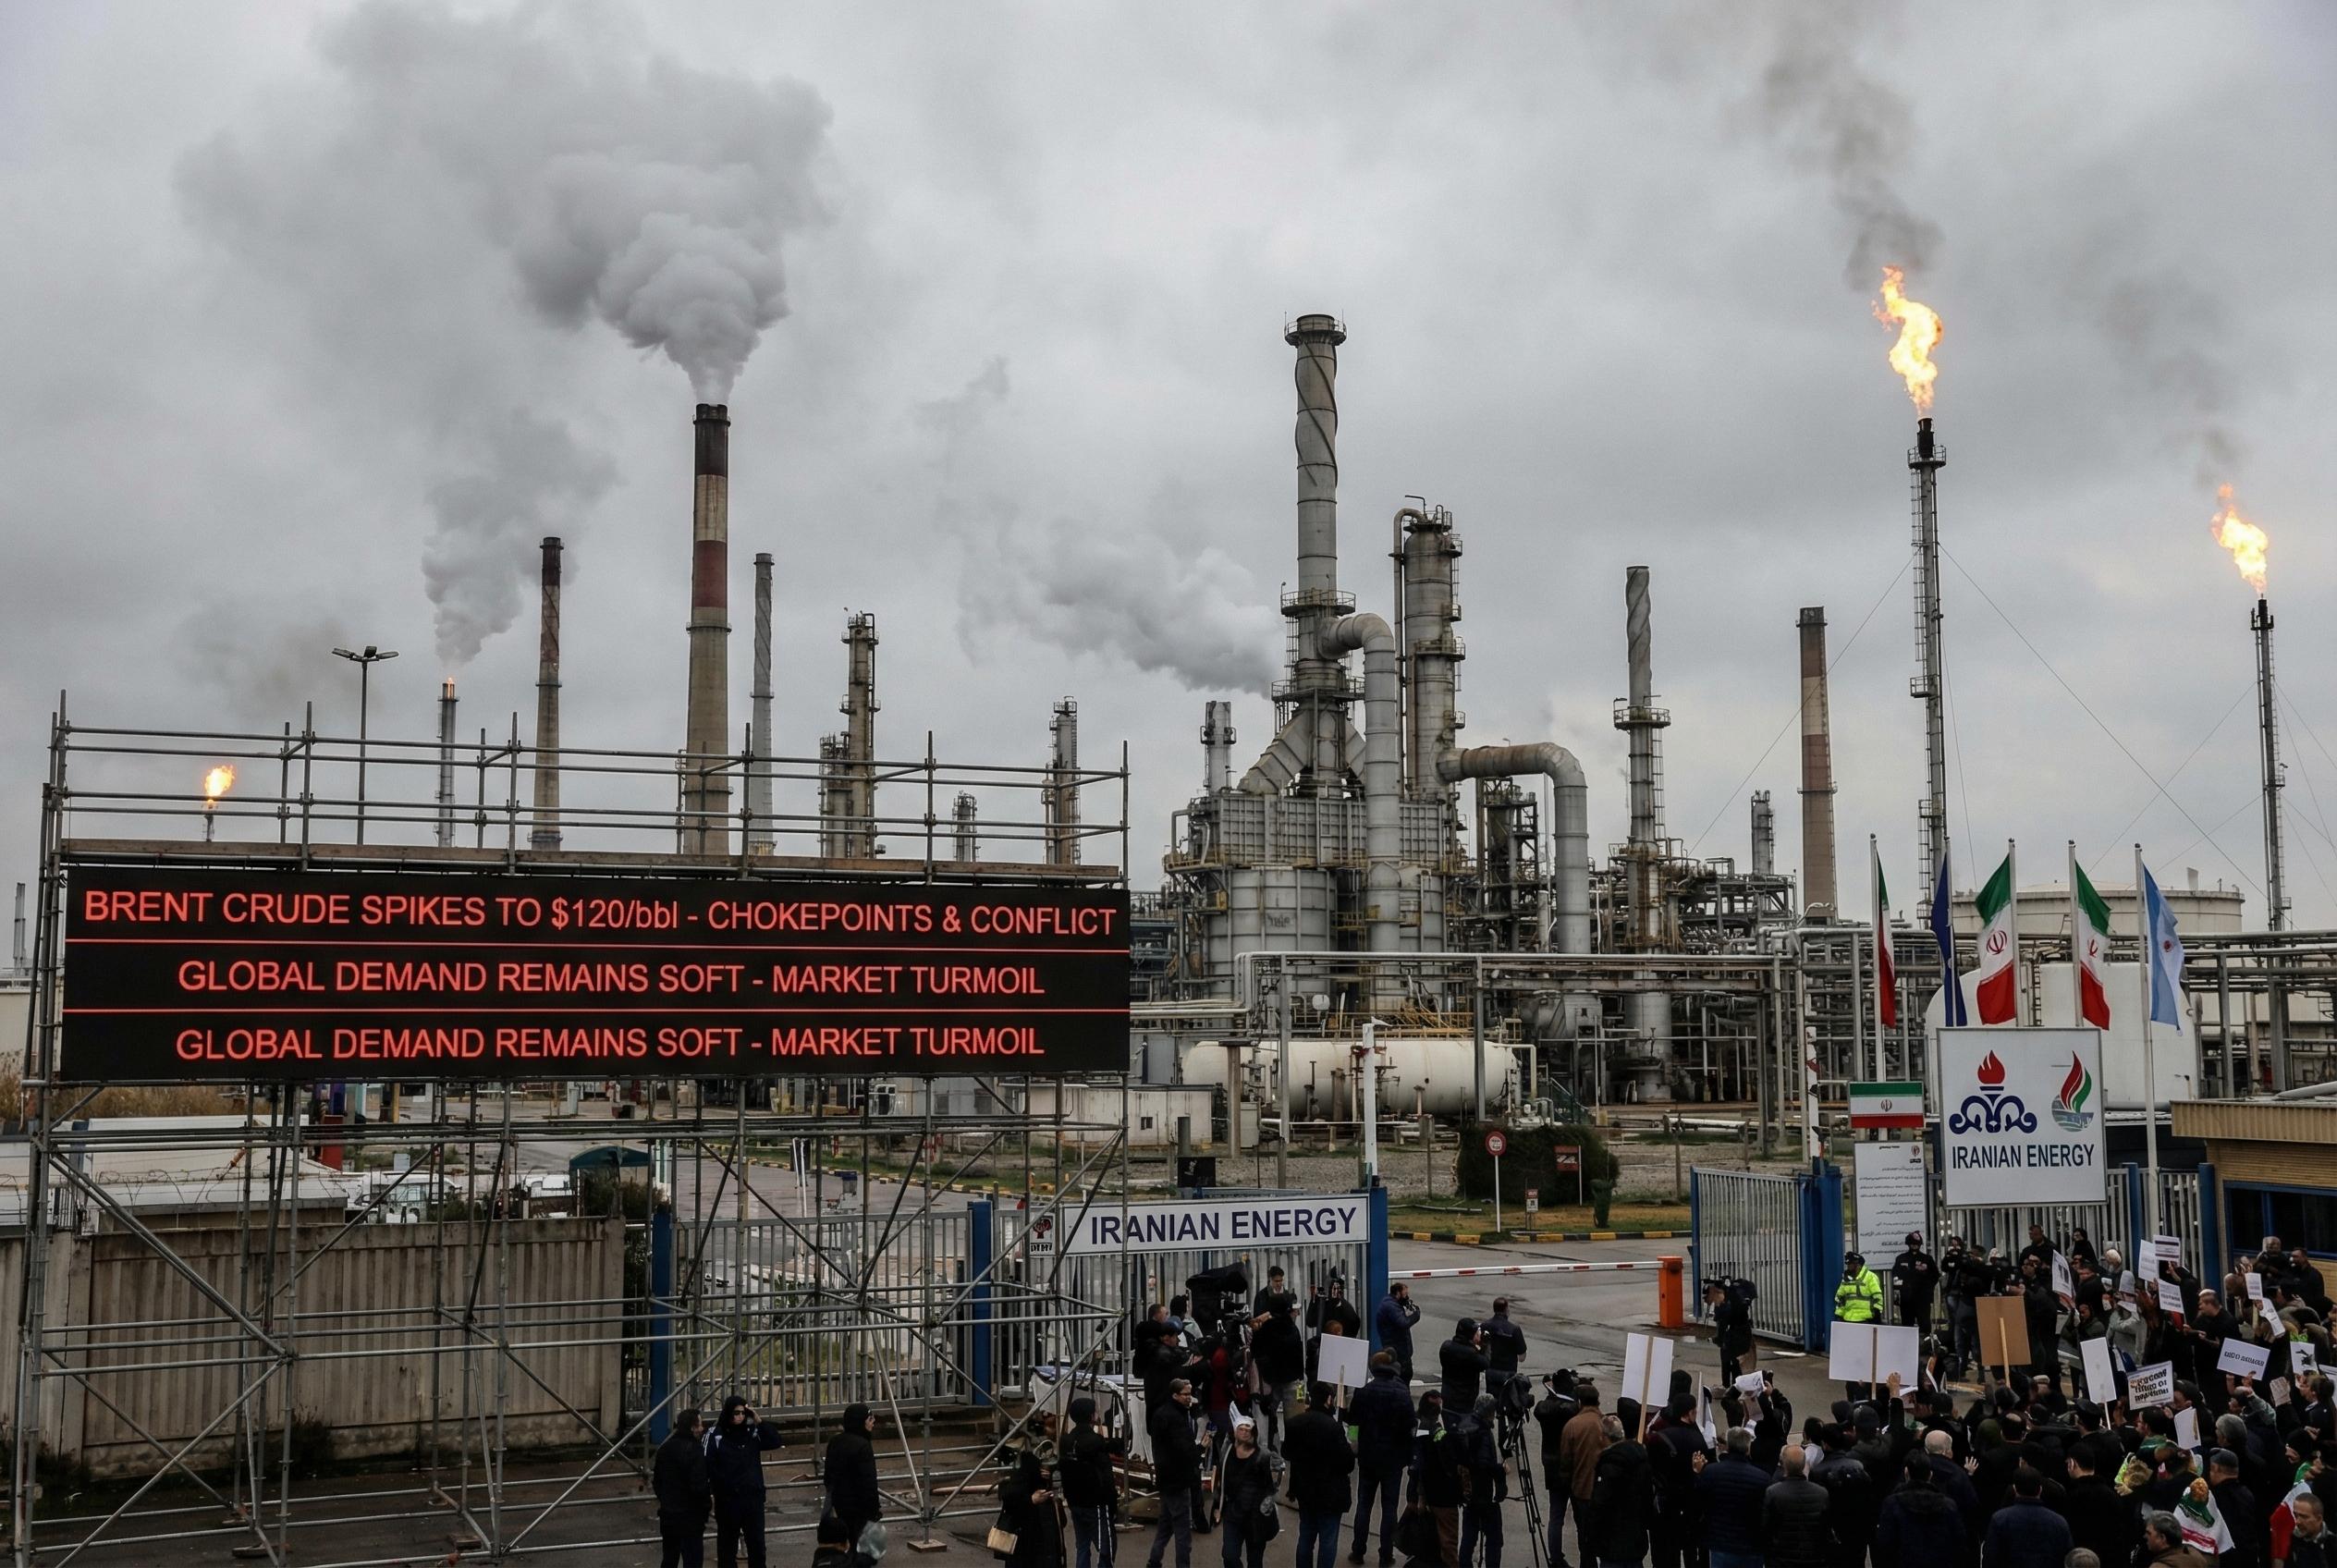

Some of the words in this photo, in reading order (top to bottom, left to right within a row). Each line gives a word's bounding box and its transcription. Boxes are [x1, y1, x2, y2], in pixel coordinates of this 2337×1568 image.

[85, 890, 214, 923] BRENT
[223, 892, 350, 924] CRUDE
[361, 895, 485, 926] SPIKES
[495, 897, 542, 926] TO
[551, 896, 678, 930] $120/bbl
[708, 900, 933, 933] CHOKEPOINTS
[942, 905, 962, 933] &
[971, 905, 1117, 936] CONFLICT
[178, 960, 325, 992] GLOBAL
[336, 962, 487, 992] DEMAND
[498, 962, 649, 993] REMAINS
[658, 963, 745, 993] SOFT
[773, 965, 903, 993] MARKET
[910, 966, 1046, 994] TURMOIL
[176, 1028, 323, 1060] GLOBAL
[333, 1028, 484, 1059] DEMAND
[496, 1027, 647, 1058] REMAINS
[657, 1027, 743, 1057] SOFT
[772, 1027, 902, 1056] MARKET
[909, 1027, 1045, 1056] TURMOIL
[1952, 1145, 2022, 1170] IRANIAN
[2026, 1144, 2095, 1168] ENERGY
[1091, 1211, 1220, 1245] IRANIAN
[1231, 1206, 1358, 1240] ENERGY
